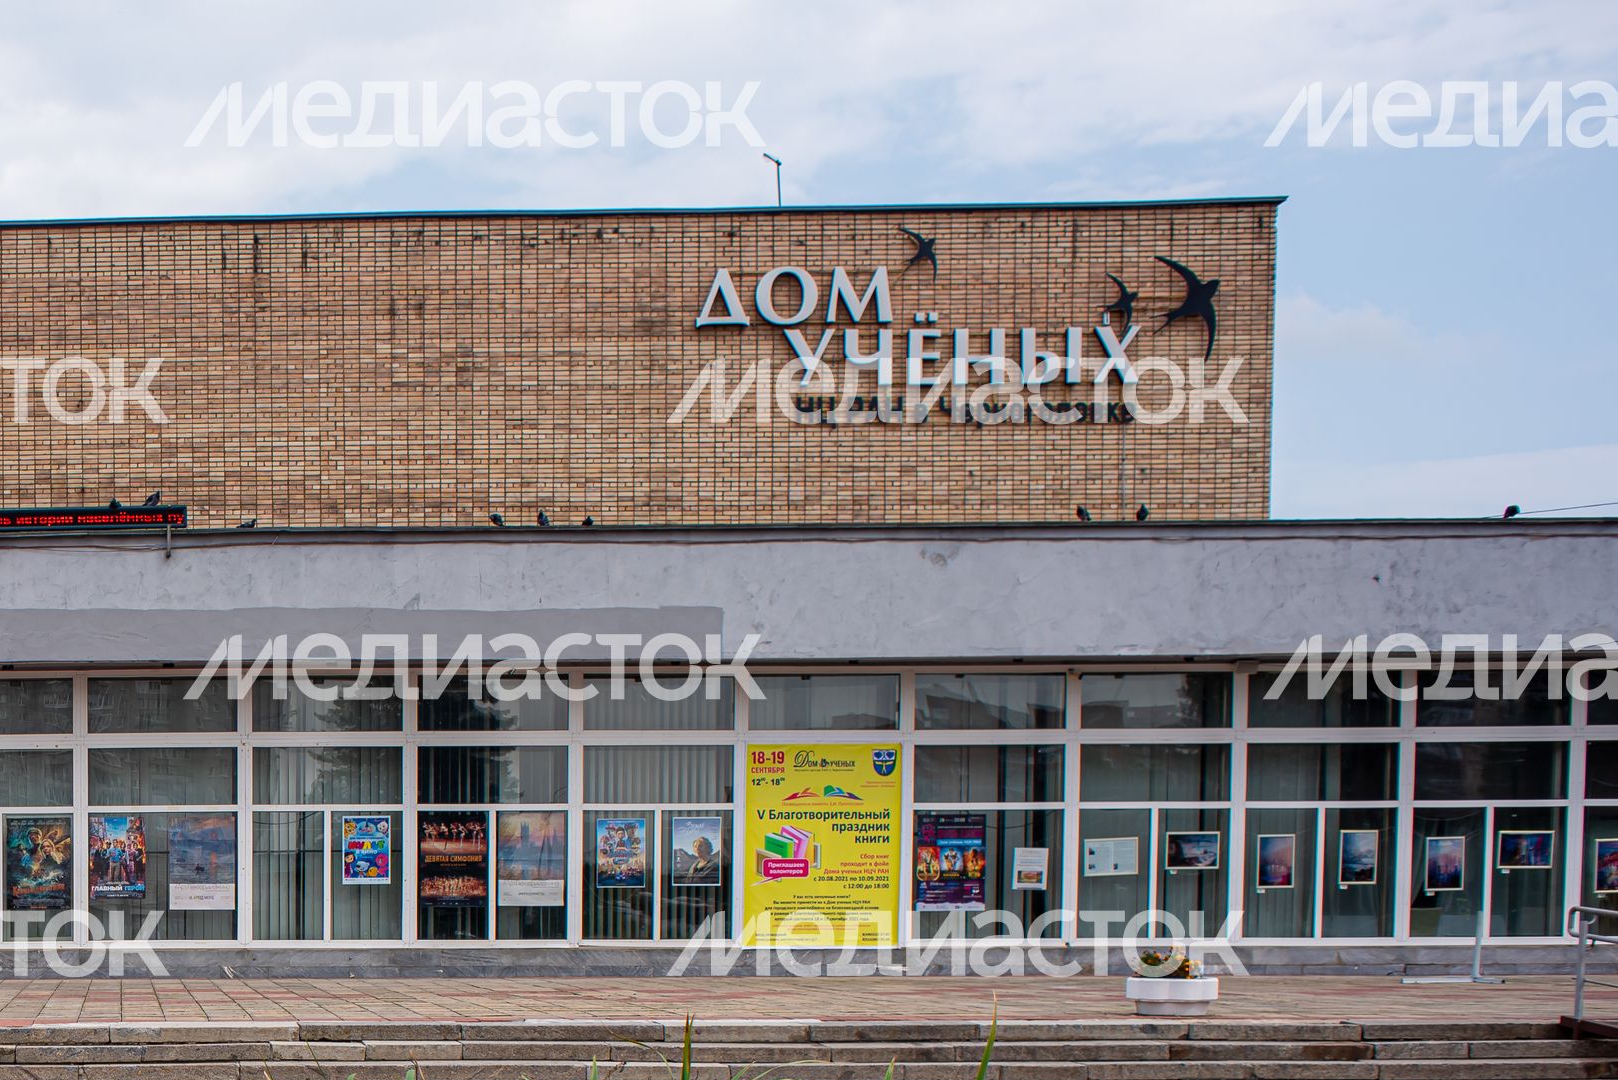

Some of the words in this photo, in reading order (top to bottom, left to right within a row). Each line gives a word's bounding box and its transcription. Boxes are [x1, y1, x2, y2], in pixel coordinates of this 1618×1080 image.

[695, 266, 893, 327] ДОМ
[785, 312, 1141, 386] УЧЁНЫХ
[16, 515, 73, 527] истории
[751, 751, 785, 764] 18-19
[757, 809, 765, 819] V
[769, 808, 890, 822] Благотворительный
[832, 823, 890, 834] праздник
[855, 835, 890, 844] книги
[425, 855, 449, 863] ДЕВЯТАЯ
